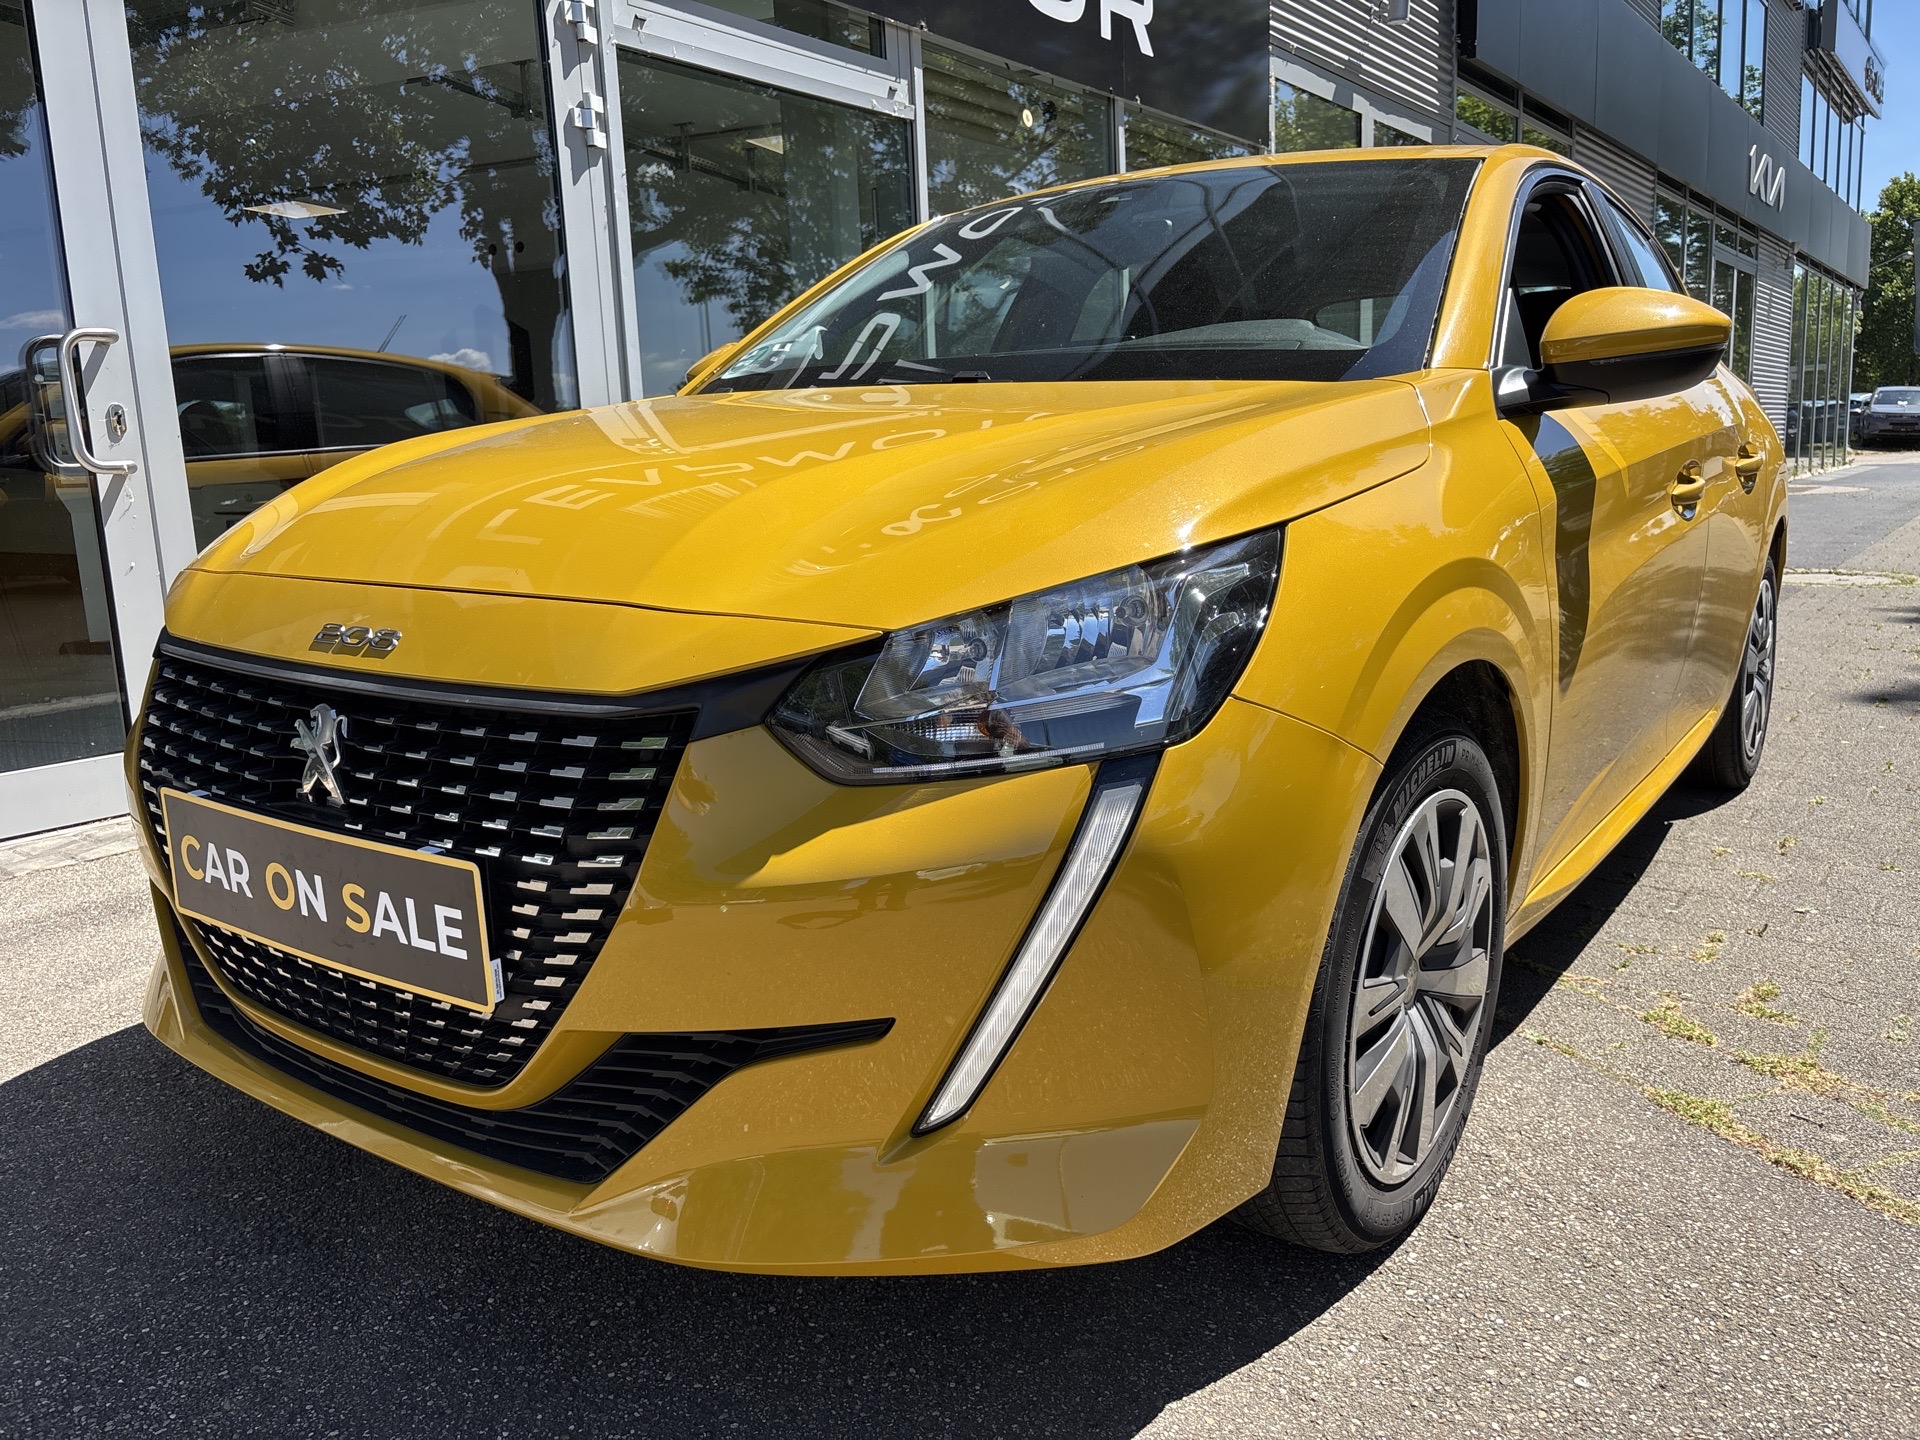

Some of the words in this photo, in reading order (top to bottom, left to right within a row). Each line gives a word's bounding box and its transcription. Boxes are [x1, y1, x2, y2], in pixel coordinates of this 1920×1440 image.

[313, 622, 402, 650] 208
[1393, 744, 1455, 833] MICHELIN
[181, 835, 253, 899] CAR
[265, 862, 328, 923] ON
[342, 883, 468, 960] SALE
